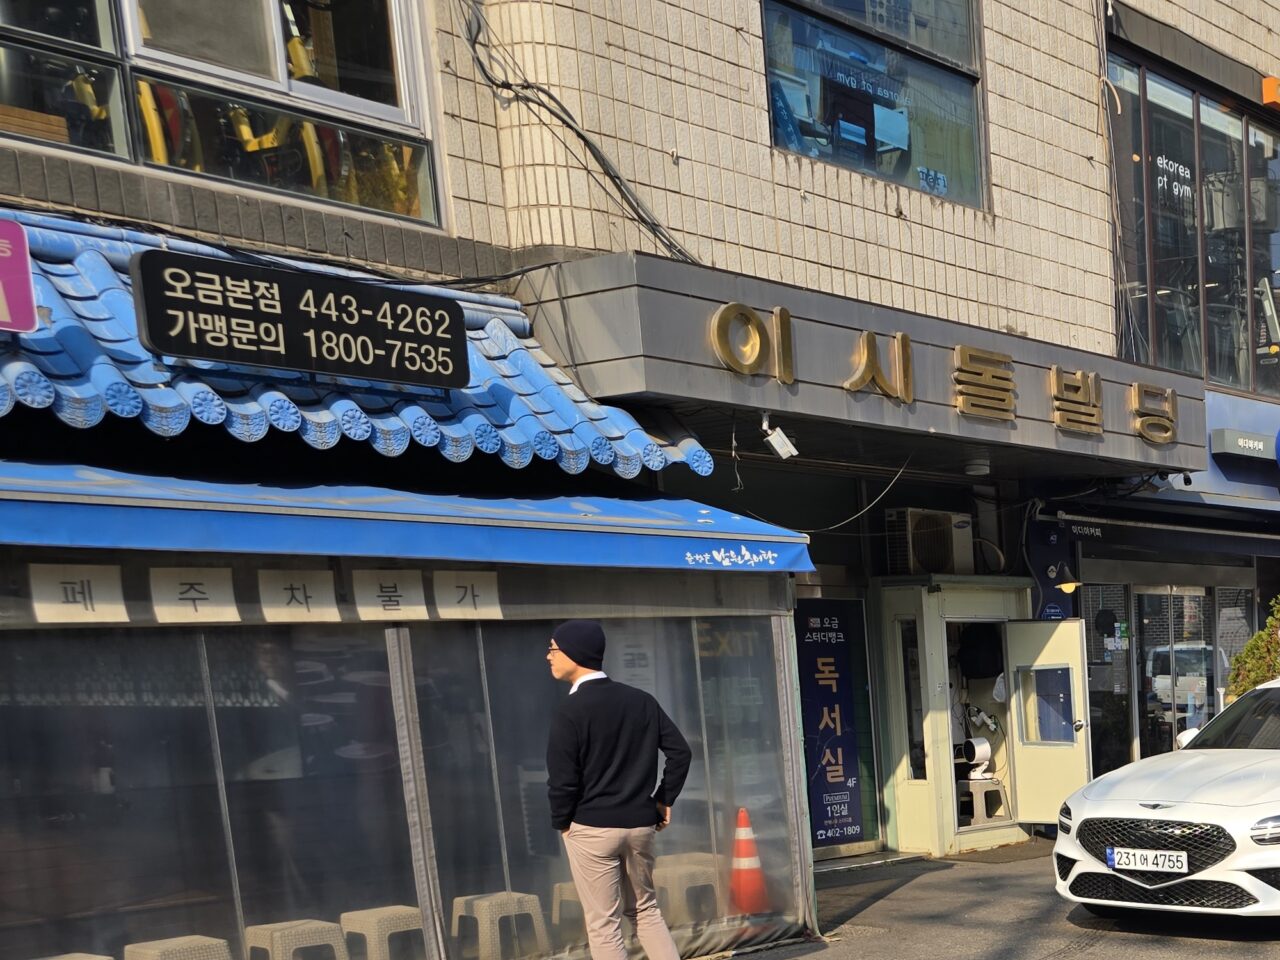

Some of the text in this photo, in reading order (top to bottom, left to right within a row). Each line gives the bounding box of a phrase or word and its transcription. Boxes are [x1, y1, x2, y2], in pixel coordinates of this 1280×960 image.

[1157, 155, 1191, 179] ekorea
[1157, 175, 1192, 198] pt gym
[163, 267, 452, 339] 오금본점 443-4262
[166, 309, 454, 375] 가맹문의 1800-7535
[823, 617, 839, 629] 오금
[805, 632, 845, 643] 스터디뱅크
[815, 657, 845, 783] 독서실
[846, 777, 857, 788] 4F
[826, 803, 849, 817] 1인실
[826, 825, 861, 838] 402-1809
[1151, 853, 1184, 870] 4755
